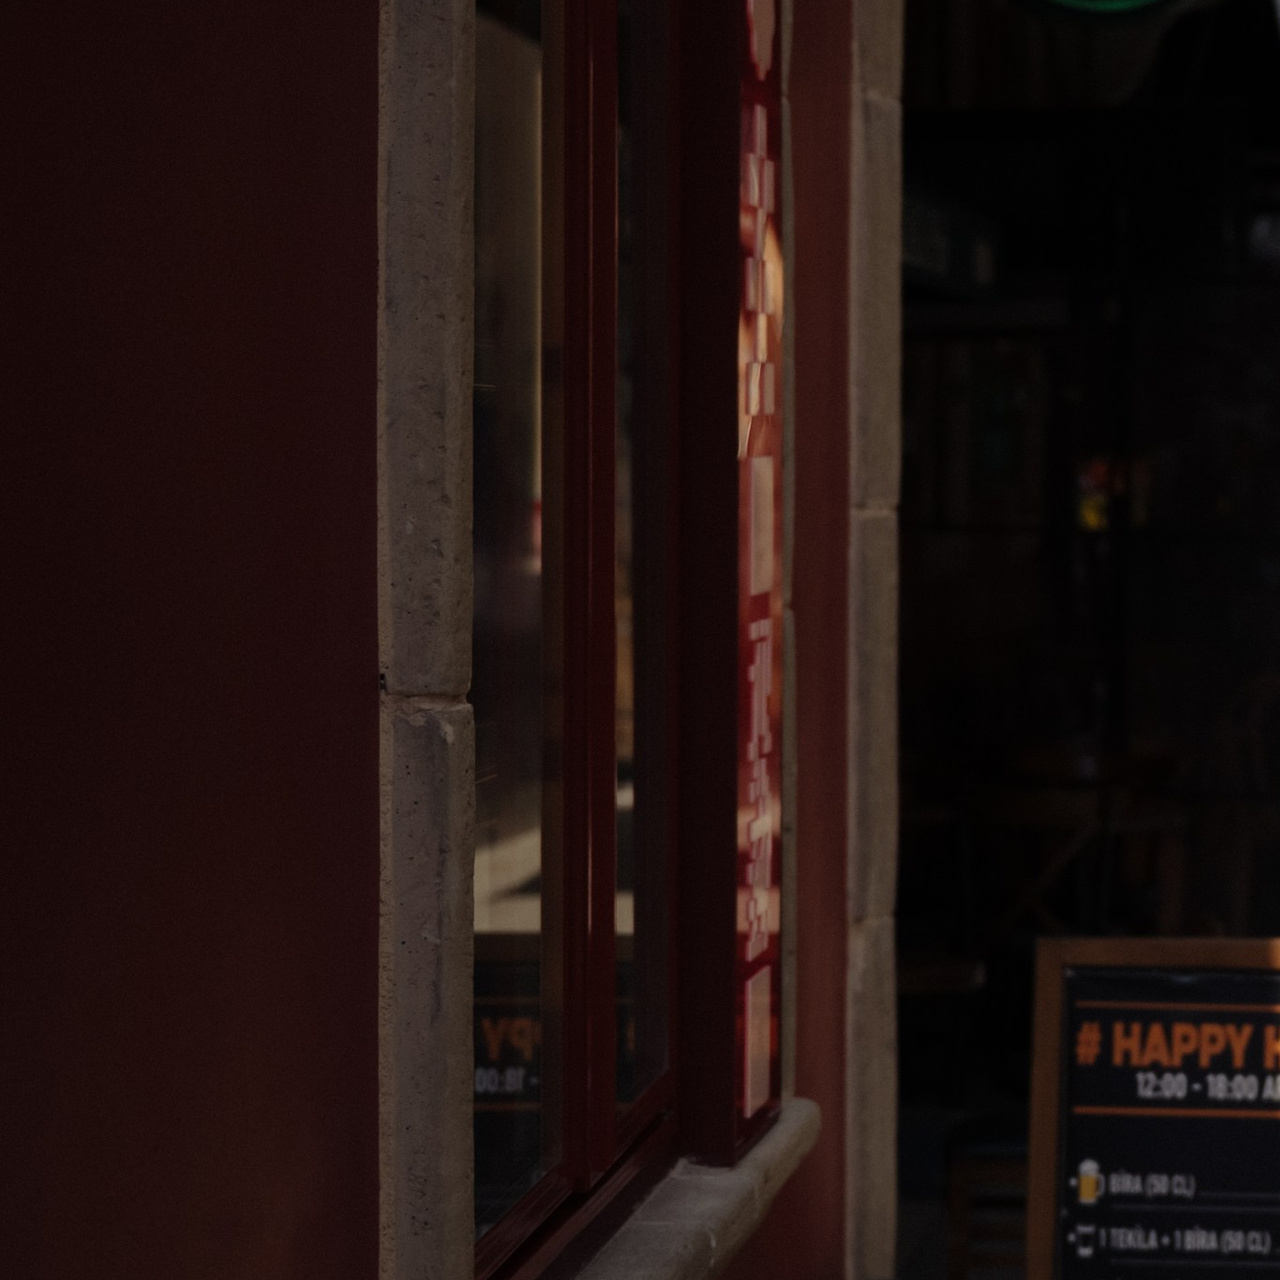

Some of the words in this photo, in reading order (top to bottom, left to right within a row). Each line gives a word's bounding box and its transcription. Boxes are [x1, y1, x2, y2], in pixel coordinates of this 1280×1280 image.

[1112, 1020, 1254, 1070] HAPPY
[1135, 1071, 1188, 1100] 12:00
[1206, 1073, 1259, 1102] 18:00
